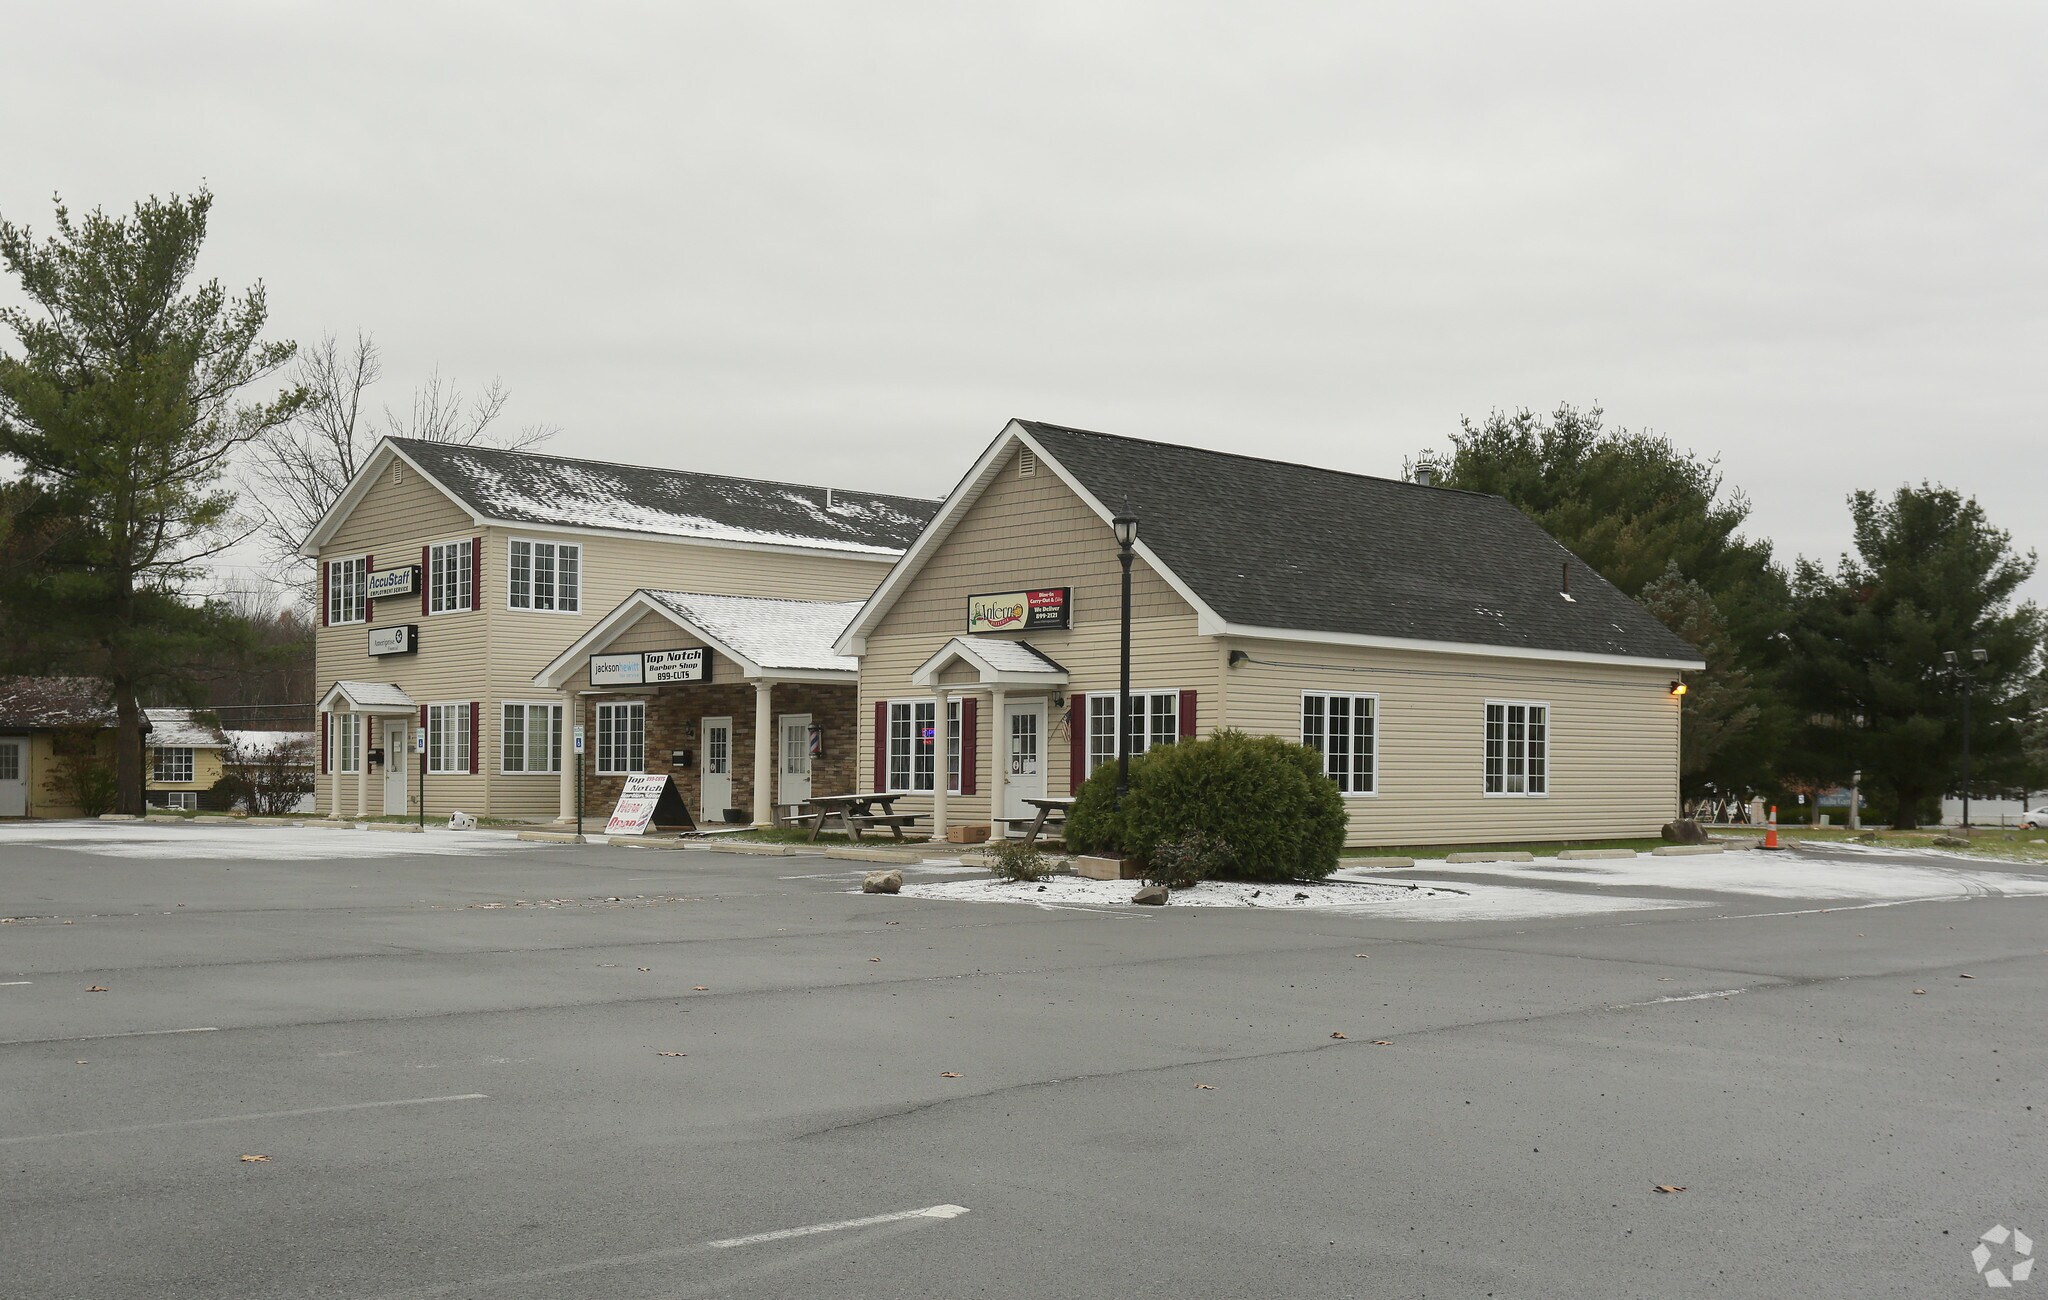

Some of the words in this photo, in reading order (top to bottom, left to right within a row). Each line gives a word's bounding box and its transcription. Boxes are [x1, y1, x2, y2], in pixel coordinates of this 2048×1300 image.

[369, 570, 410, 589] AccuStaff
[370, 588, 393, 596] EMPLOYMENT
[982, 601, 1023, 620] Inferno
[646, 653, 664, 663] Top
[667, 650, 701, 661] Notch
[657, 670, 690, 680] 899-CUTS
[627, 776, 645, 784] Top
